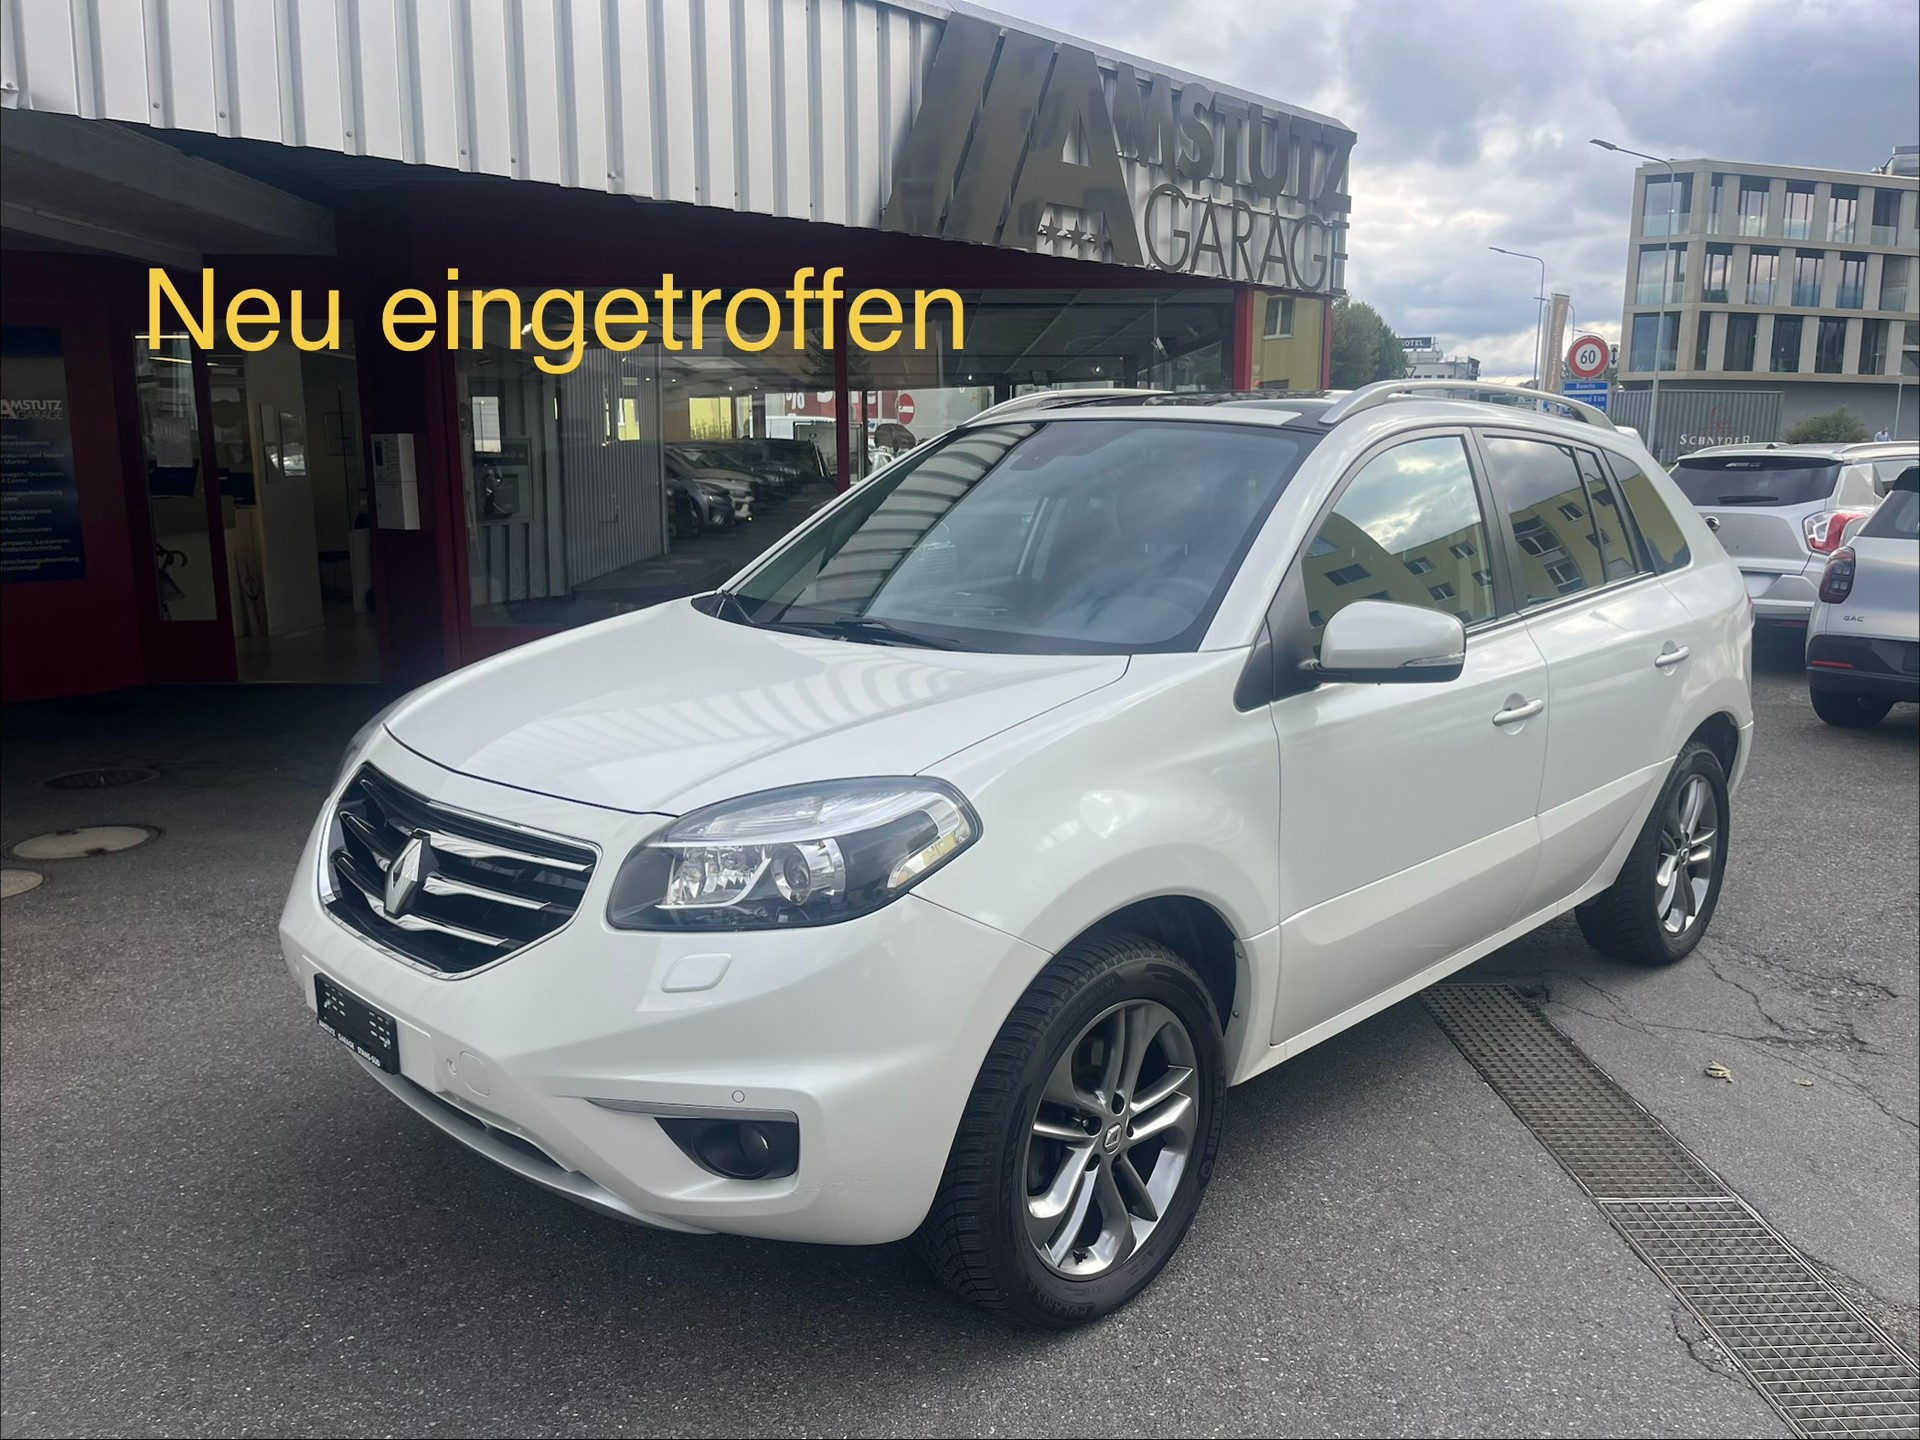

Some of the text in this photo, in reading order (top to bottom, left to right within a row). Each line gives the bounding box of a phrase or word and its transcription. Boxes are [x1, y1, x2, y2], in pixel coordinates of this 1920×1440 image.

[997, 42, 1358, 266] AMSTUTZ
[1144, 183, 1350, 296] GARAGE
[1580, 350, 1596, 364] 60
[17, 410, 64, 420] GARAGE
[1679, 433, 1751, 445] SCHNYDER
[1034, 1291, 1088, 1319] POLARIS
